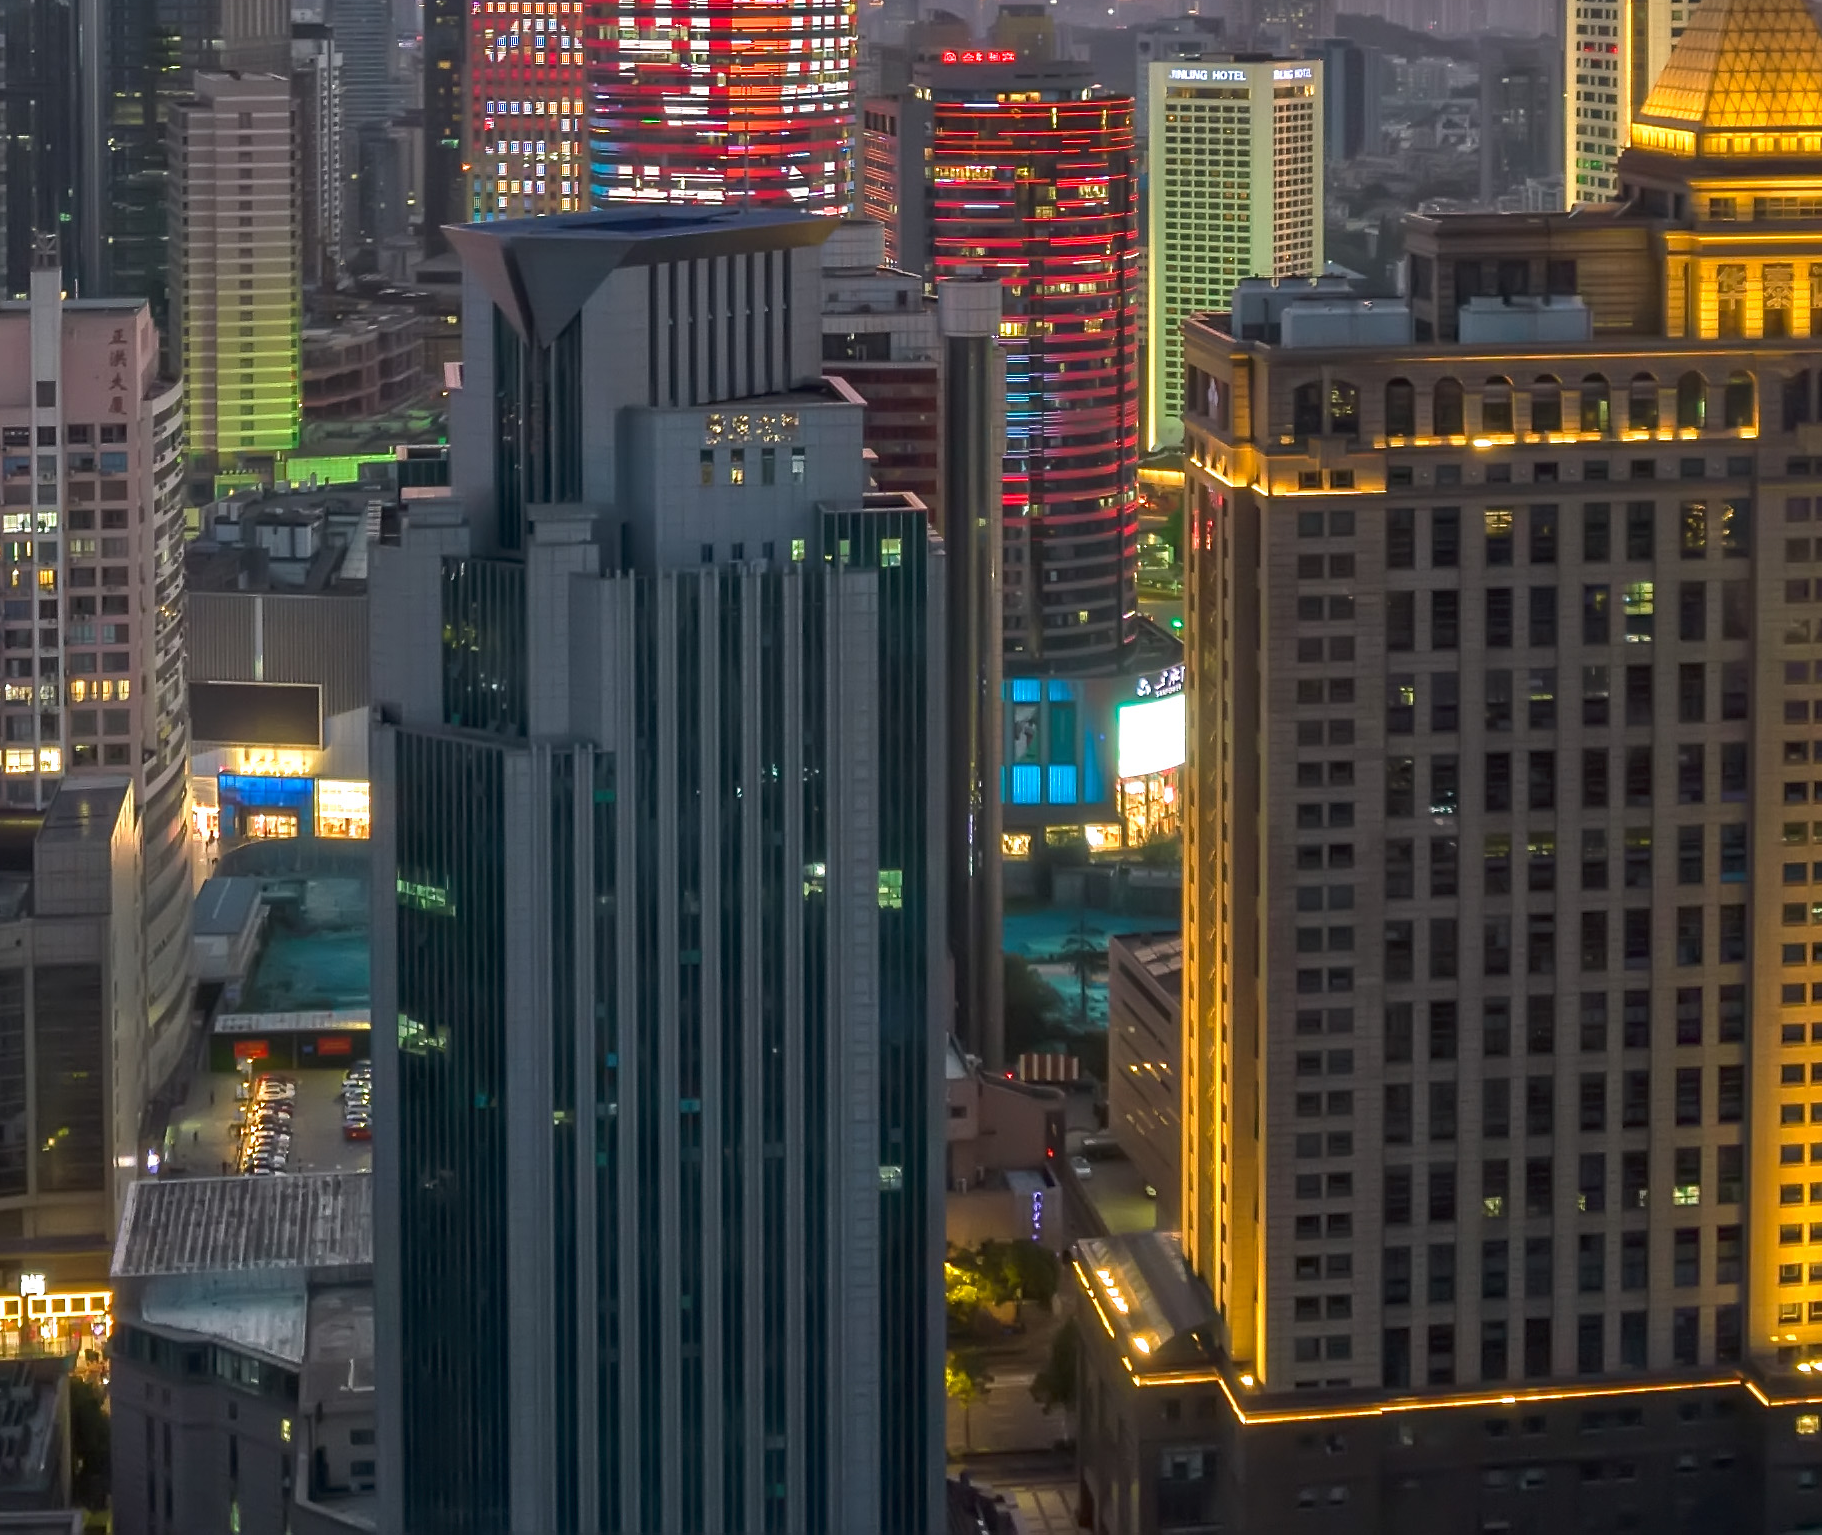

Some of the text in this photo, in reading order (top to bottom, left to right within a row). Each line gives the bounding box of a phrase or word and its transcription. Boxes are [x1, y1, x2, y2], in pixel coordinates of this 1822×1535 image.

[1169, 69, 1246, 80] JINLING HOTEL
[108, 328, 128, 414] 正洪大厦
